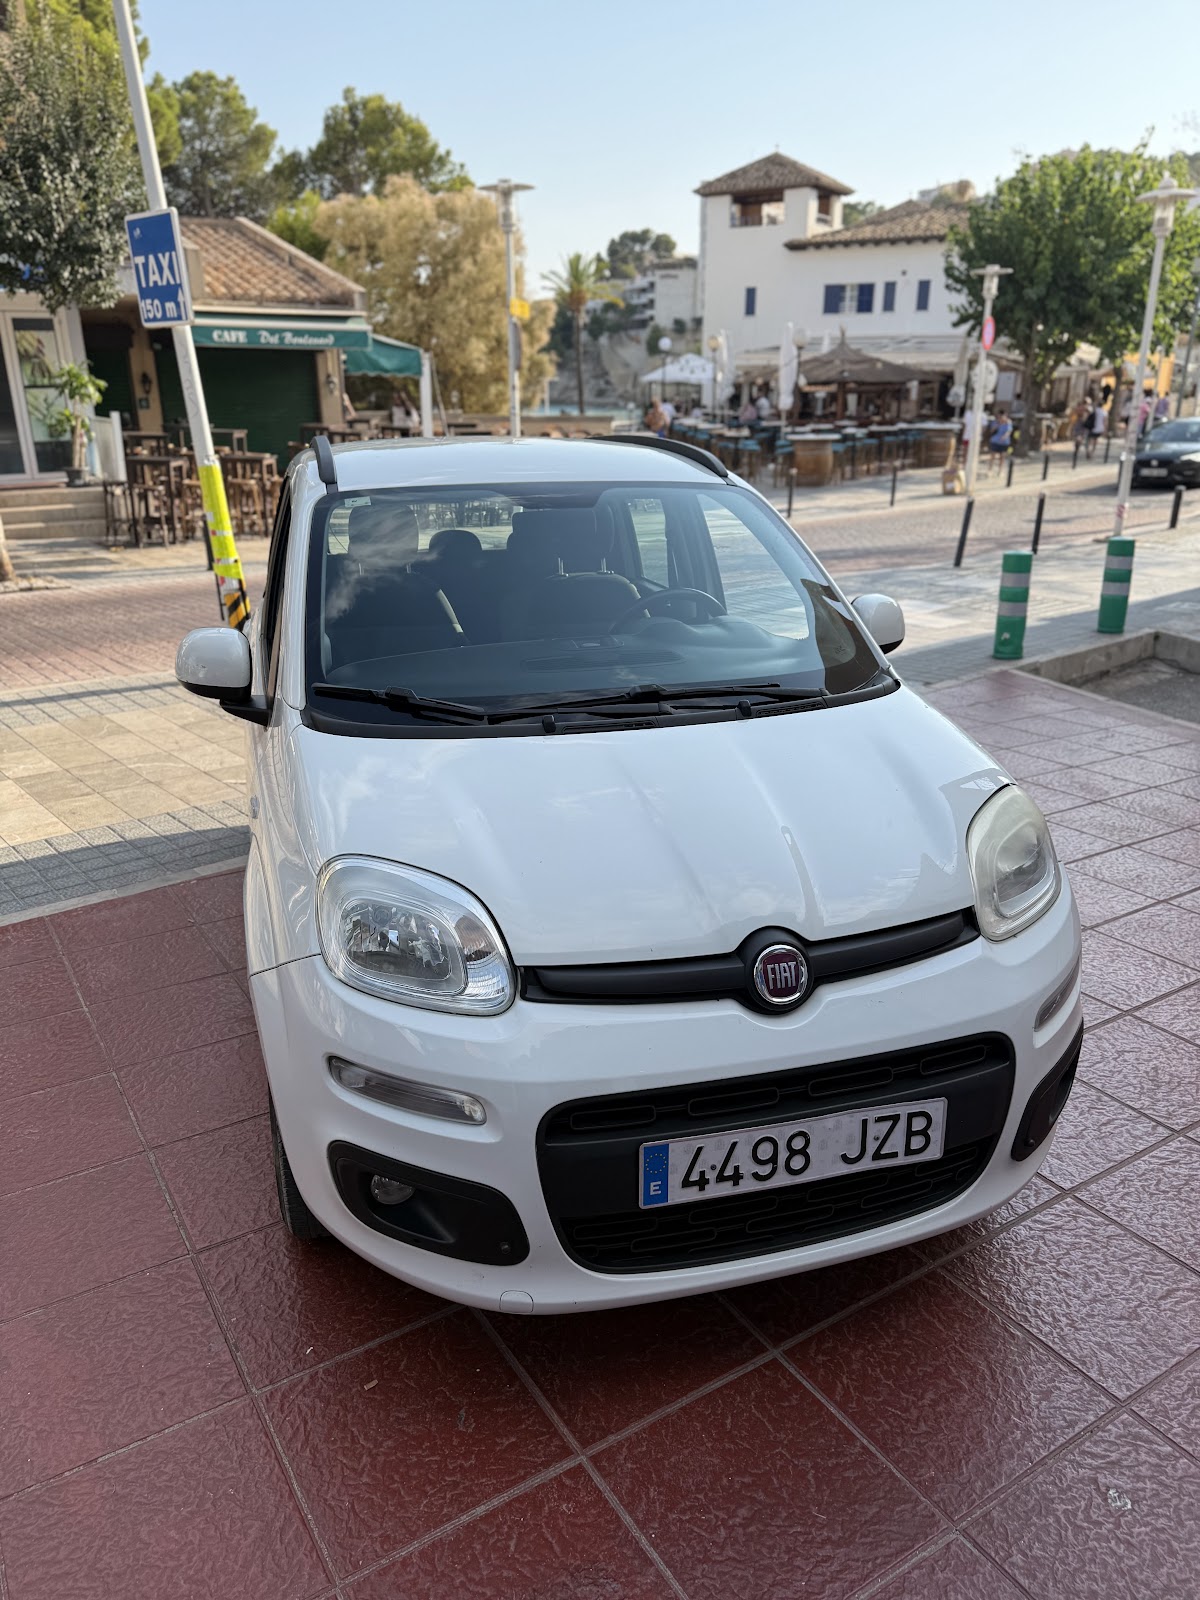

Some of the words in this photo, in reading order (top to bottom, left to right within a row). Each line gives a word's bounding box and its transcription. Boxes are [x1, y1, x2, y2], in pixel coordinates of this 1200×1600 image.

[134, 251, 181, 288] TAXI
[140, 299, 162, 319] 150
[165, 301, 177, 318] m
[212, 329, 247, 344] CAFE
[766, 961, 797, 990] FIAT
[681, 1130, 811, 1191] 4498
[840, 1110, 933, 1165] JZB
[649, 1181, 662, 1195] E
